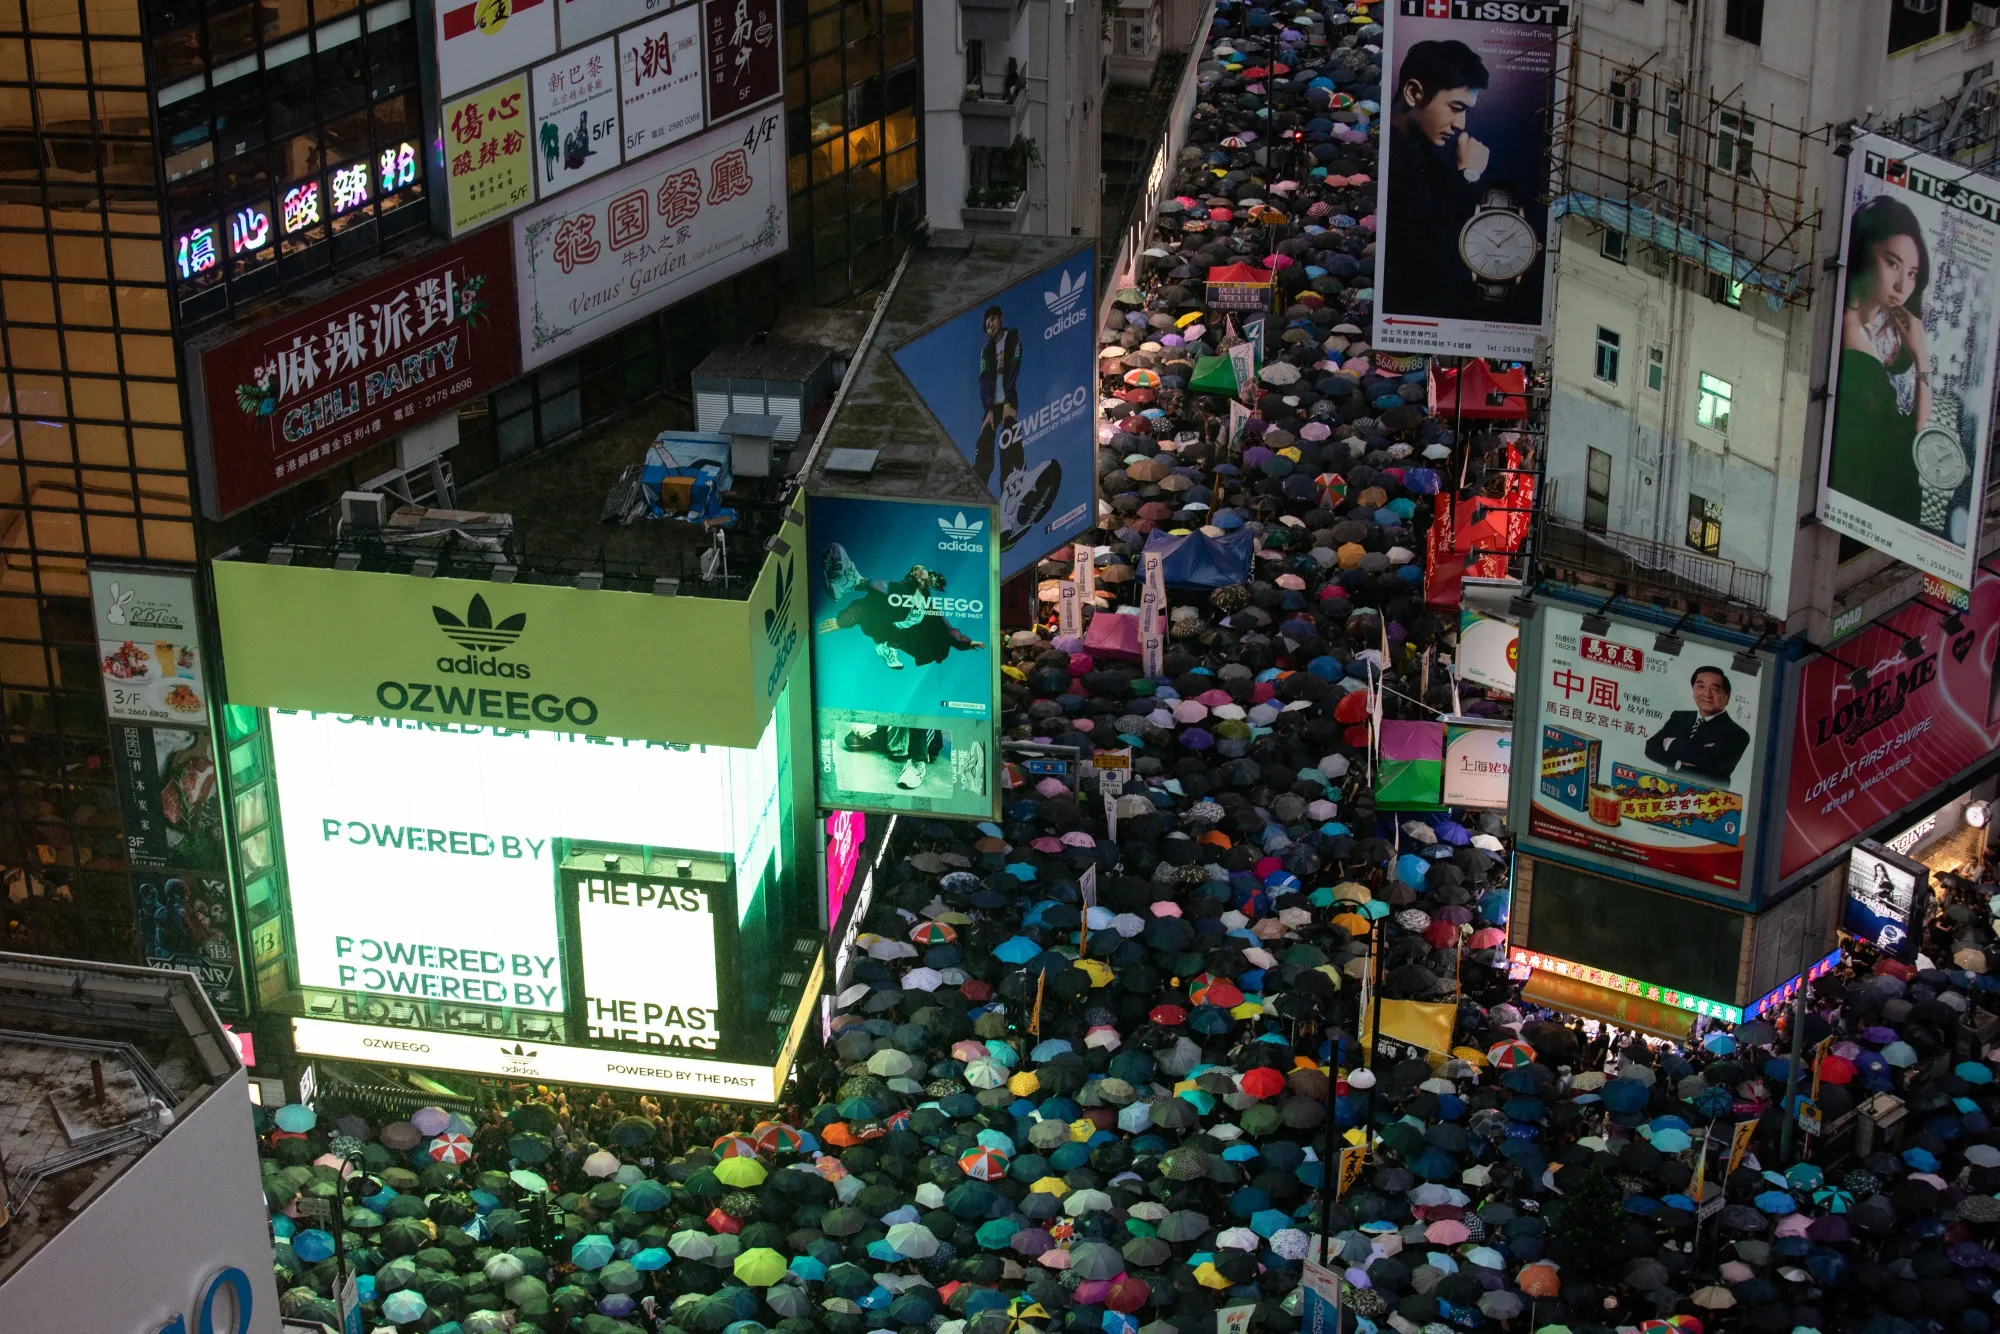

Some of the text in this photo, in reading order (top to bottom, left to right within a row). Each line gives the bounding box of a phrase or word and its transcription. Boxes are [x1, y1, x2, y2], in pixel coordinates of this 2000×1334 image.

[1455, 0, 1560, 23] TISSOT
[1491, 27, 1552, 38] #ThisIsYourTime
[632, 32, 672, 87] 潮
[713, 16, 725, 84] 台式料理
[548, 54, 603, 93] 新巴黎
[562, 97, 588, 116] Vietnamese
[588, 87, 613, 103] Restaurant
[739, 86, 751, 100] 5F
[451, 93, 521, 144] 傷心
[593, 117, 615, 141] 5/F
[627, 130, 645, 149] 5/F
[743, 114, 779, 155] 4/F
[452, 130, 525, 177] 酸辣粉
[510, 184, 528, 203] 5/F
[1911, 169, 2000, 221] TISSOT
[177, 142, 416, 279] 傷心酸辣粉
[553, 149, 753, 274] 花園餐廳
[622, 226, 692, 267] 牛扒之家
[630, 252, 687, 297] Garden
[278, 270, 455, 402] 麻辣派對
[1044, 307, 1086, 341] adidas
[1375, 353, 1423, 372] 5649 6988
[1503, 346, 1521, 354] 2518
[282, 335, 459, 442] CHILI PARTY
[275, 419, 382, 479] 香港銅鑼灣金百利4樓
[425, 389, 448, 407] 2178
[450, 378, 472, 395] 4898
[999, 386, 1087, 450] OZWEEGO
[1051, 420, 1059, 432] BY
[1060, 413, 1072, 425] THE
[1072, 404, 1087, 420] PAST
[938, 540, 984, 553] adidas
[1930, 560, 1946, 573] 2534
[1947, 567, 1964, 580] 2523
[888, 593, 984, 613] OZWEEGO
[1923, 577, 1969, 611] 5649 6988
[913, 609, 945, 618] POWERED
[1833, 606, 1862, 634] POAD
[767, 621, 797, 698] adidas
[1555, 642, 1576, 652] 1822年
[1587, 653, 1636, 670] MA PAK LEUNG
[1588, 639, 1637, 665] 馬百良
[436, 655, 531, 680] adidas
[1645, 656, 1668, 668] SINCE
[113, 689, 141, 705] 3/F
[375, 681, 599, 726] OZWEEGO
[1553, 668, 1621, 712] 中風
[1623, 691, 1650, 706] 年輕化
[1815, 652, 1938, 748] LOVE ME
[113, 706, 169, 719] Tel: 2660 6829
[1545, 700, 1648, 738] 馬百良安宮牛黃丸
[1627, 704, 1663, 720] 及早預防
[1805, 716, 1933, 804] LOVE AT FIRST SWIPE
[1860, 754, 1913, 792] #MACLOVEME
[128, 836, 145, 847] 3F
[322, 818, 547, 861] POWERED BY
[582, 878, 630, 906] HE
[1856, 891, 1903, 923] LONGINES
[335, 934, 557, 980] POWERED BY
[338, 964, 559, 1008] POWERED BY
[362, 1037, 430, 1054] OZWEEGO
[502, 1064, 540, 1077] adidas
[607, 1063, 757, 1088] POWERED BY THE PAST
